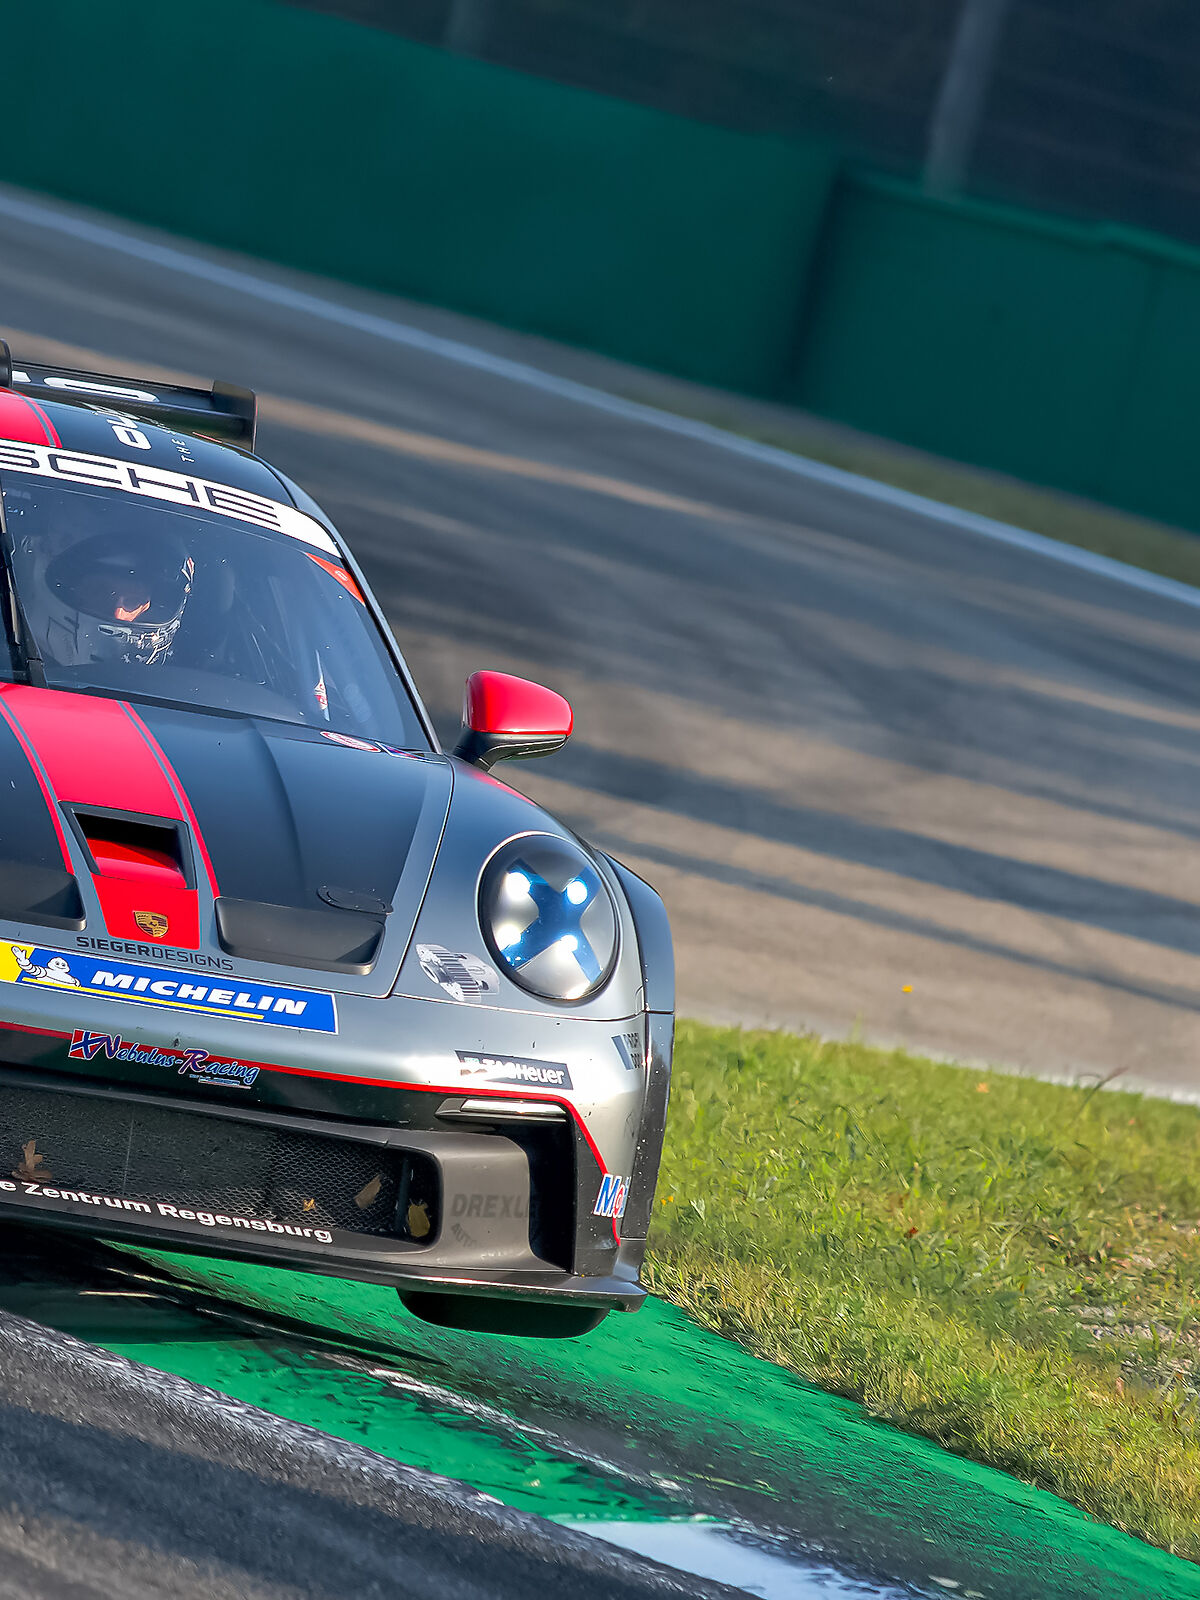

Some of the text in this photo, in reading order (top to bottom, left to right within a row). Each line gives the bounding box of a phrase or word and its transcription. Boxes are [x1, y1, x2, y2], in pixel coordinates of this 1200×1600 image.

[76, 936, 234, 971] SIEGERDESIGNS
[90, 970, 309, 1016] MICHELIN
[84, 1033, 261, 1085] Nebulus-Racing
[21, 1181, 152, 1214] Zentrum
[156, 1202, 334, 1243] Regensburg
